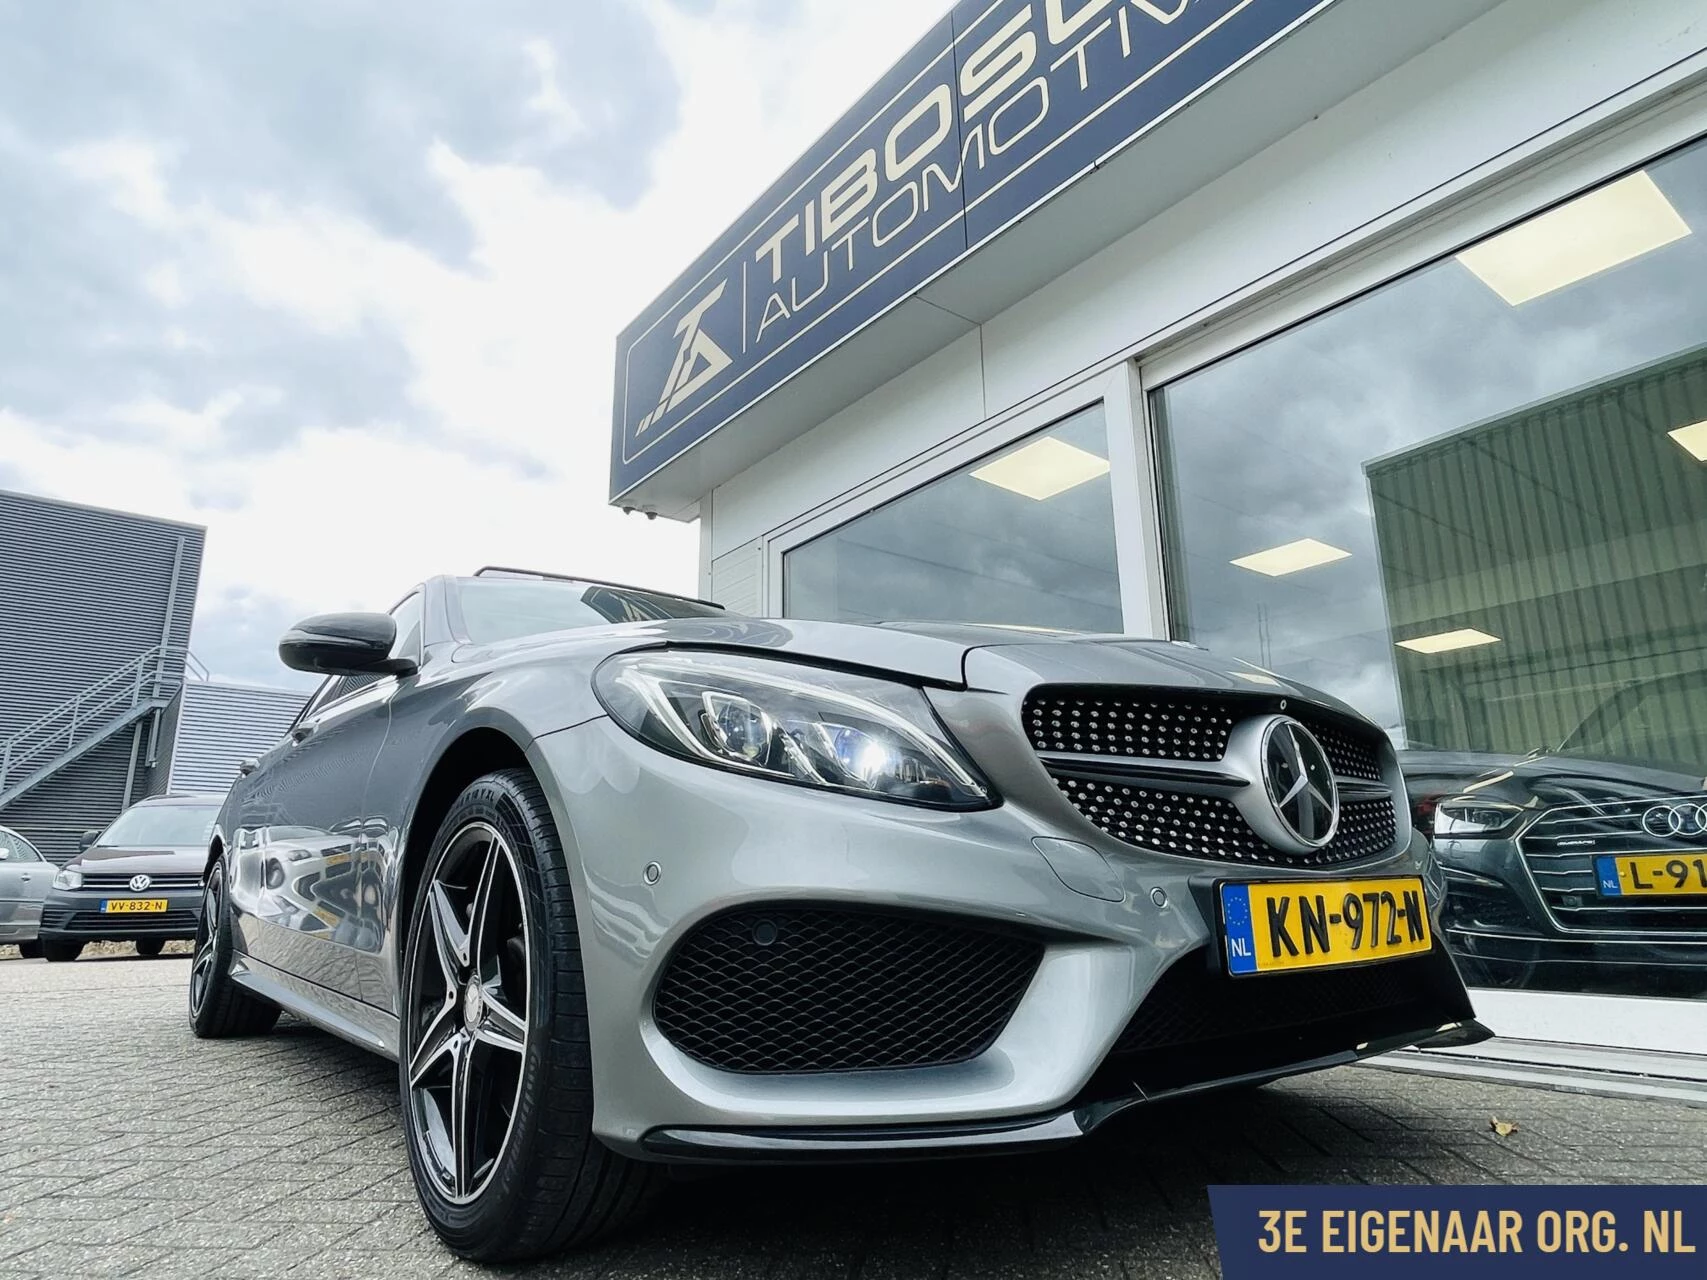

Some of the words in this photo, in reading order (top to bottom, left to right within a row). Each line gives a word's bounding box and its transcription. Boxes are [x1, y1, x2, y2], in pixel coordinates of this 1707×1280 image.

[755, 0, 1200, 343] AUTOMOTIV
[1603, 880, 1619, 889] NL
[111, 901, 163, 911] VV-832-N
[1231, 937, 1252, 958] NL
[1266, 890, 1424, 958] KN-972-N
